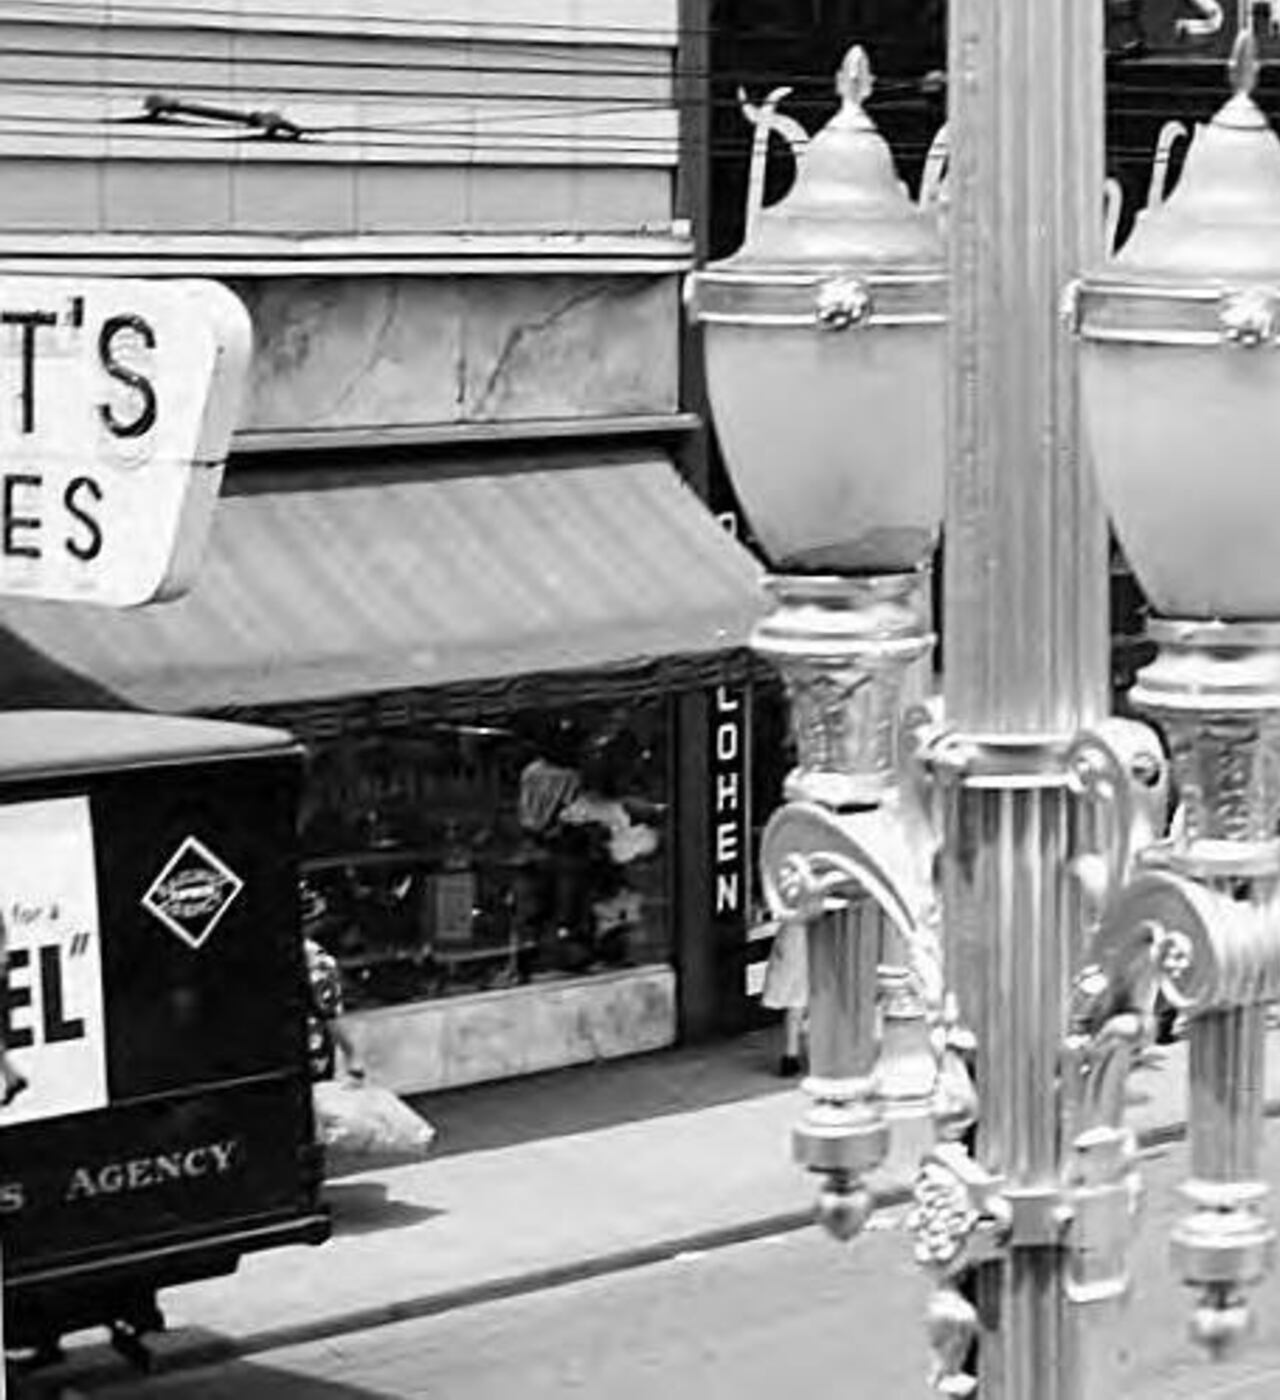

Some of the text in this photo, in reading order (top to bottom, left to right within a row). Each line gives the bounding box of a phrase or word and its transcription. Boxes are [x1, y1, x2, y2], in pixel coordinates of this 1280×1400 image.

[0, 296, 157, 439] T'S
[2, 474, 104, 561] ES
[66, 1139, 237, 1202] AGENCY
